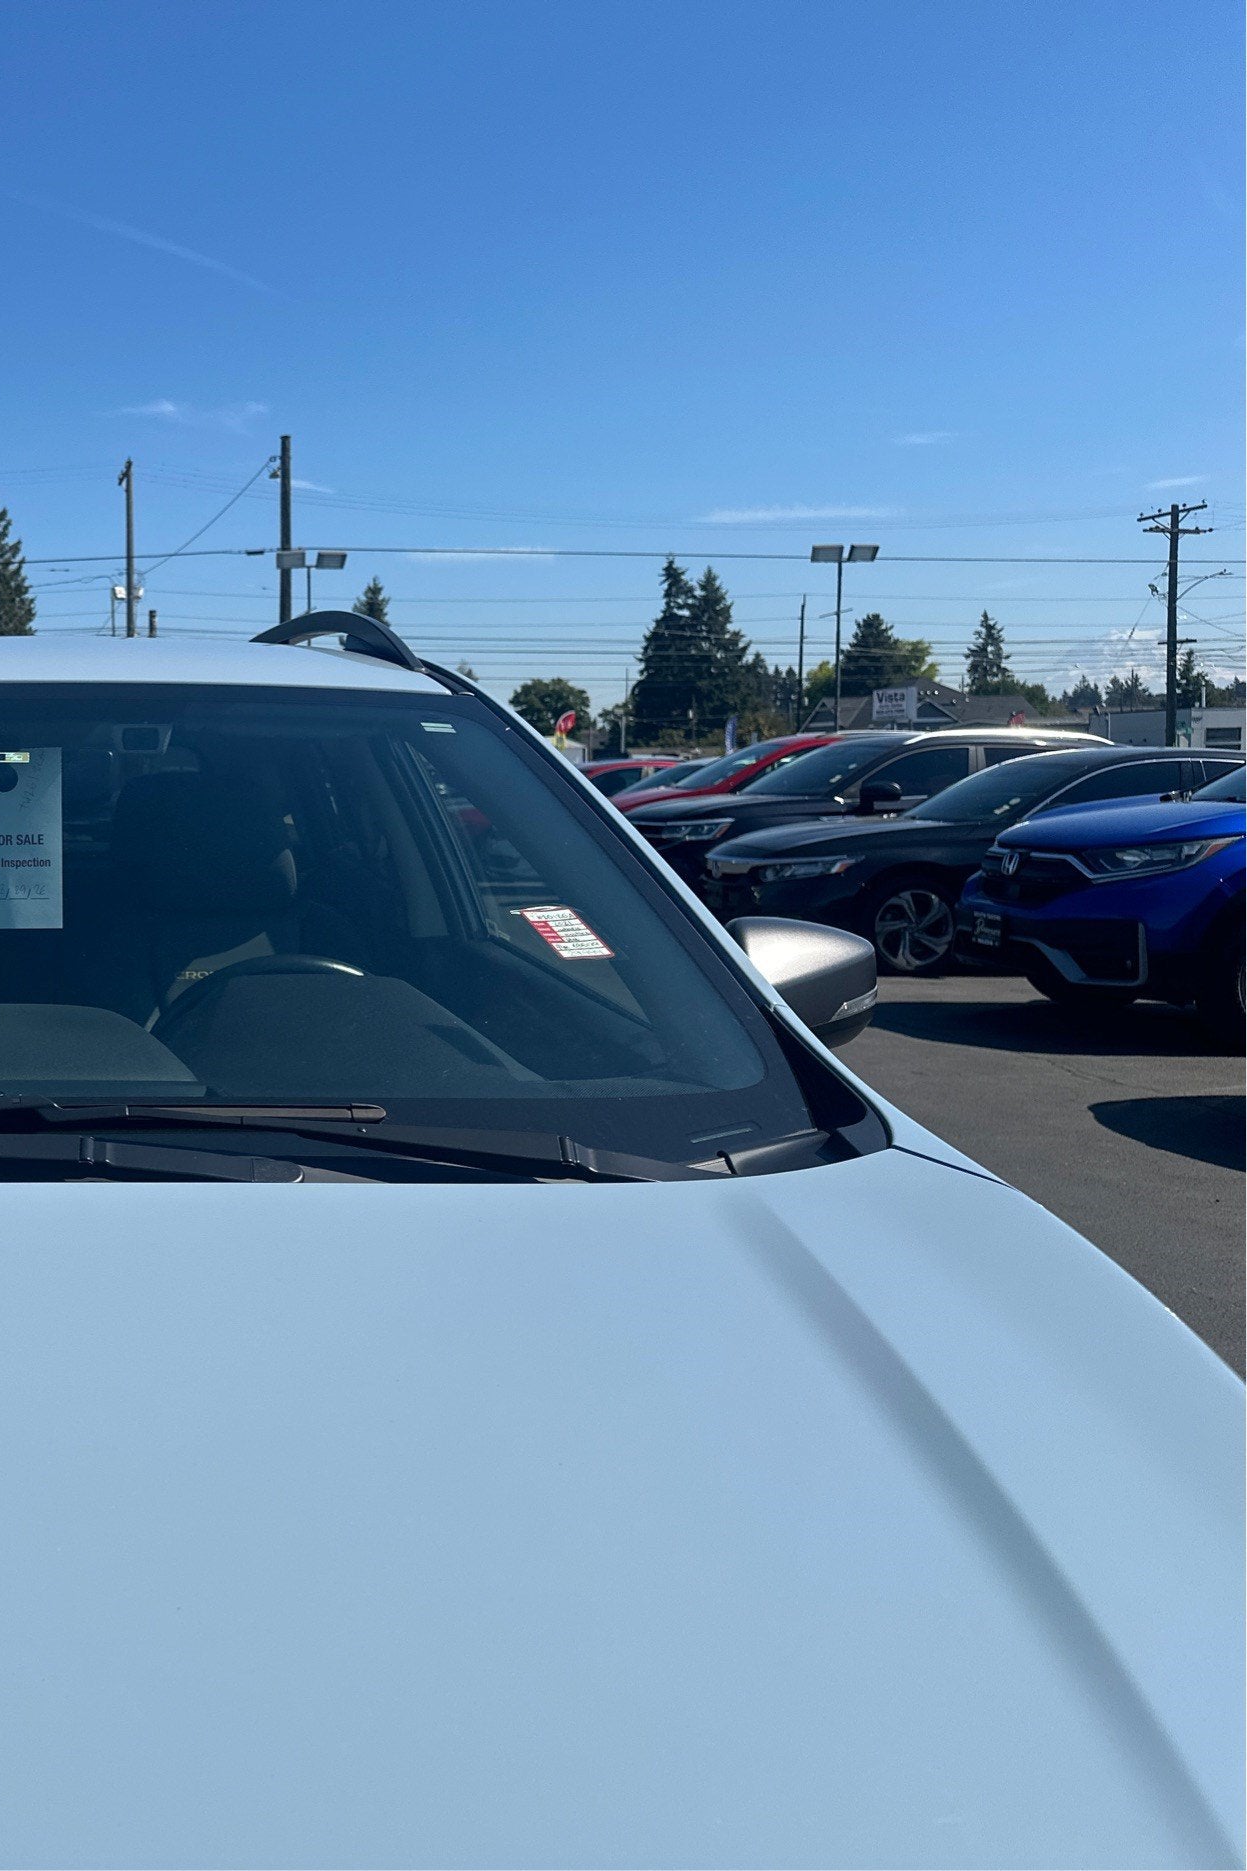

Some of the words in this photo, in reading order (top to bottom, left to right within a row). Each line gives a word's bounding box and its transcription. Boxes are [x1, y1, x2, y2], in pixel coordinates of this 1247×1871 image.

[876, 692, 906, 703] Vista
[16, 833, 44, 846] SALE
[1, 857, 51, 869] Inspection
